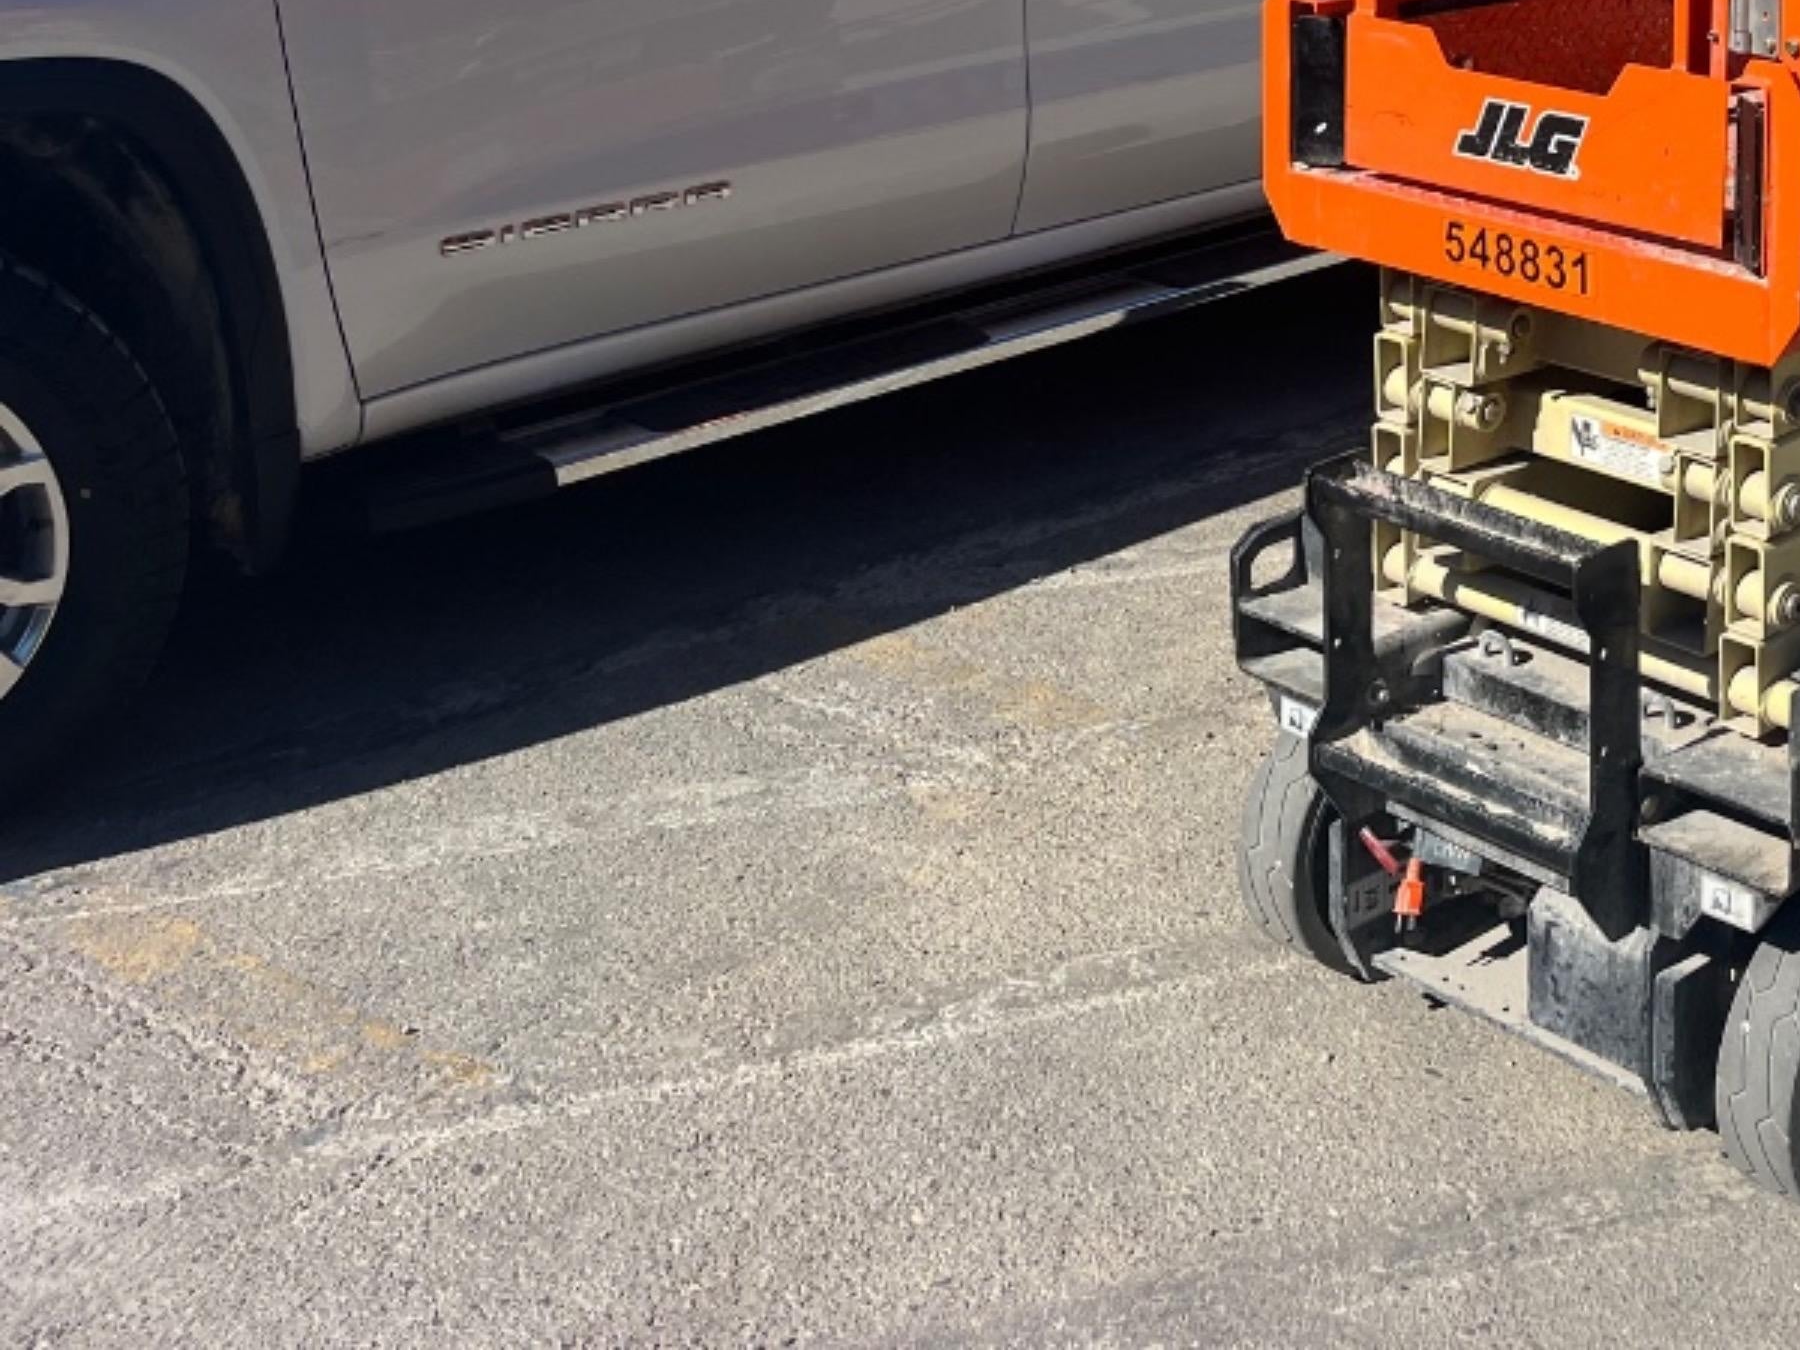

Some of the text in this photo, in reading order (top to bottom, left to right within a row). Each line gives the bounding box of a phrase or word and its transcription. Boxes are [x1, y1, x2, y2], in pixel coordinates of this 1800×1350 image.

[1454, 97, 1588, 180] JLG
[439, 179, 732, 257] SIERRA
[1445, 221, 1588, 295] 548831
